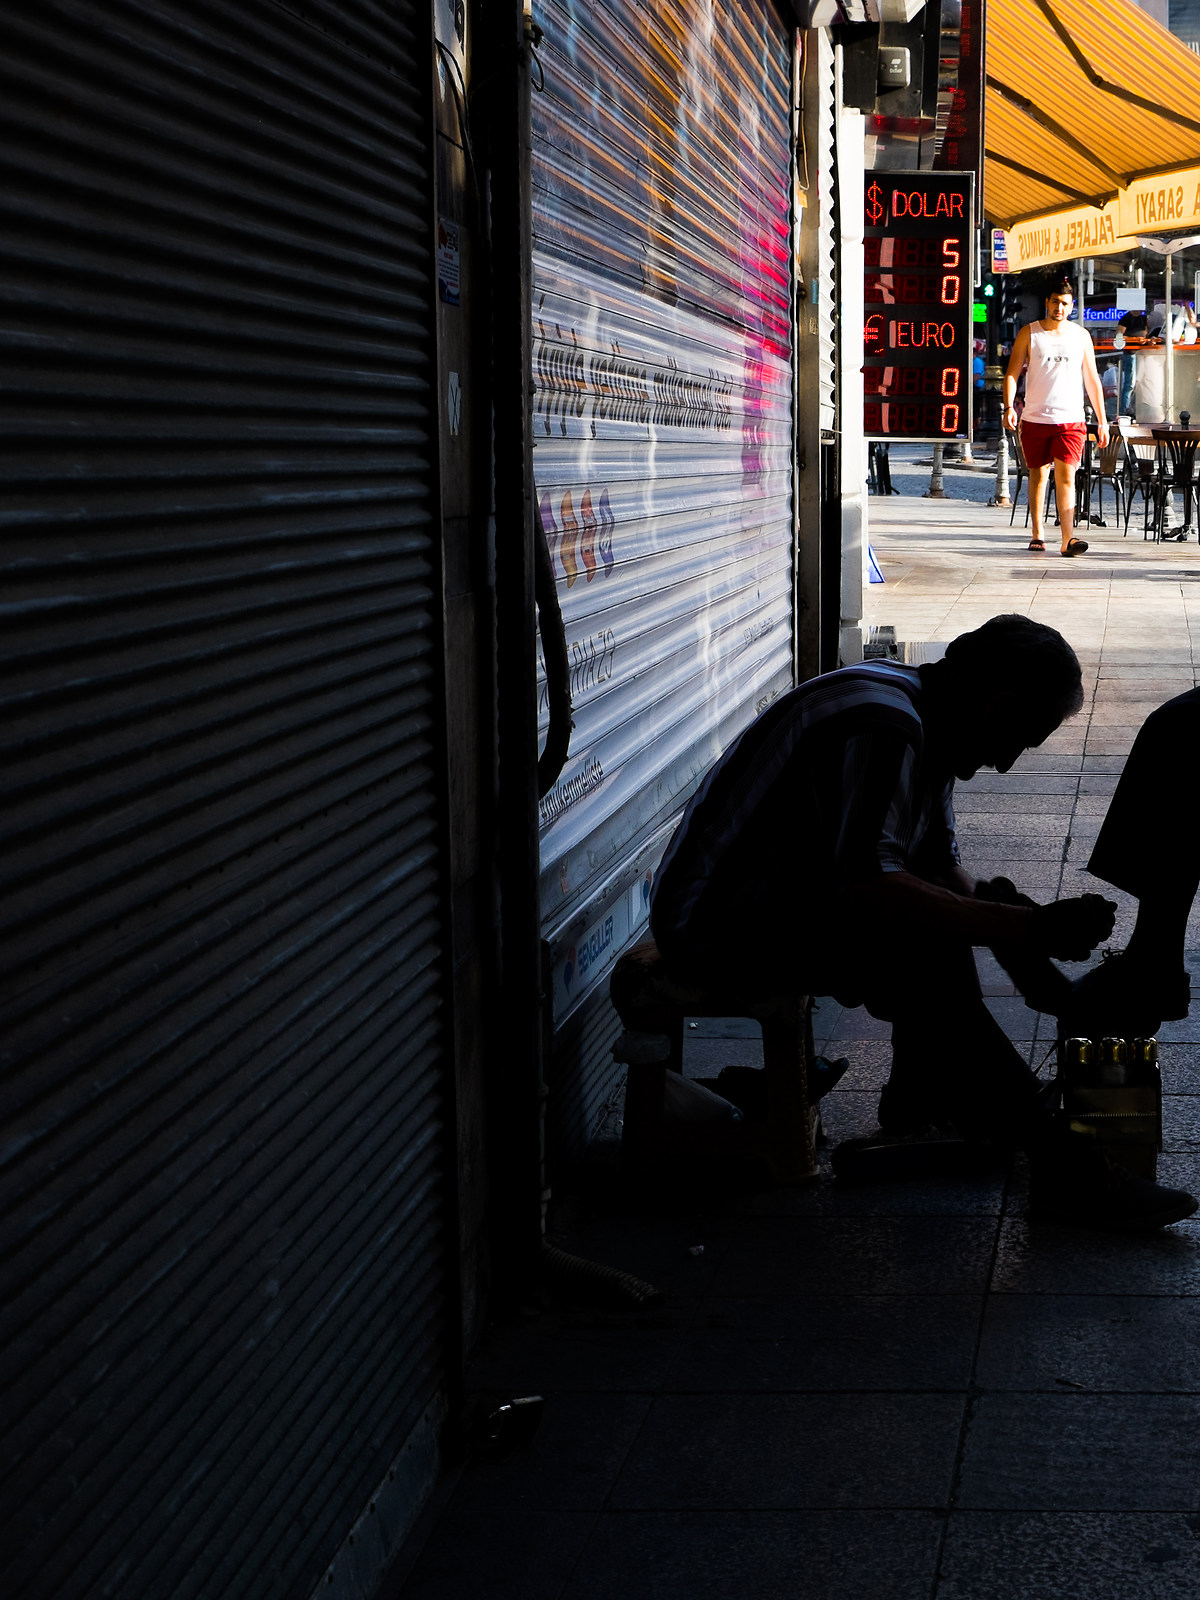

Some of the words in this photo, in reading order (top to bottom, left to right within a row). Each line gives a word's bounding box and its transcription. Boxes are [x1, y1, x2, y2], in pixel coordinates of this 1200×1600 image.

[867, 181, 882, 225] $
[894, 191, 963, 218] DOLAR
[942, 239, 960, 268] 5
[941, 276, 960, 304] 0
[1083, 308, 1128, 321] fendile
[864, 314, 884, 353] €
[898, 322, 955, 348] EURO
[941, 368, 959, 396] 0
[941, 404, 959, 432] 0
[597, 628, 615, 684] Z3
